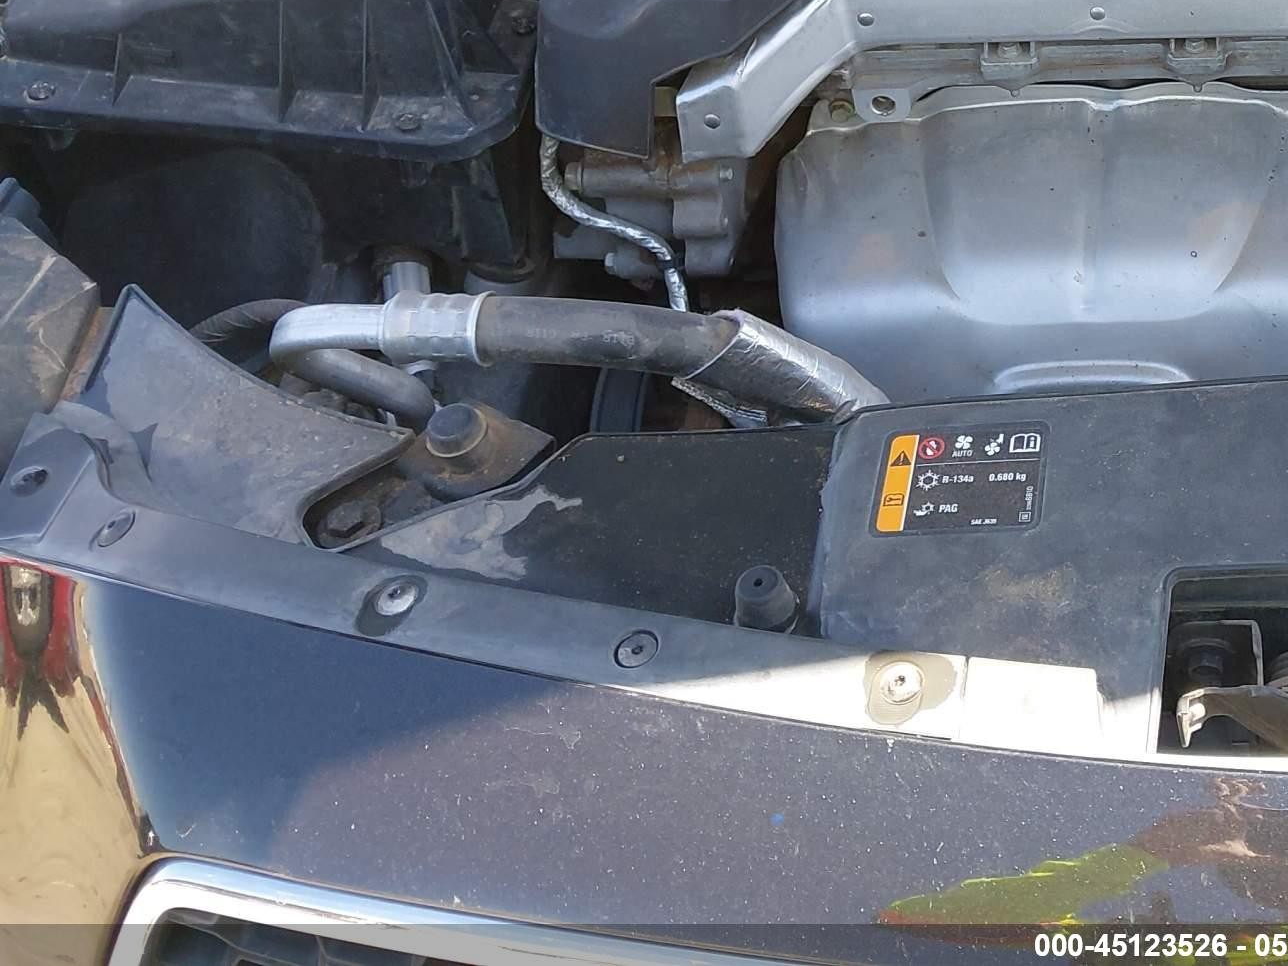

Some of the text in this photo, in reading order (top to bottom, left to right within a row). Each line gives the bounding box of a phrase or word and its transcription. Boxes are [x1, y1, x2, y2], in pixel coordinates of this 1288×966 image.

[951, 449, 974, 458] AUTO
[942, 472, 1027, 484] R-134a 0.680 kg
[938, 504, 959, 514] PAG
